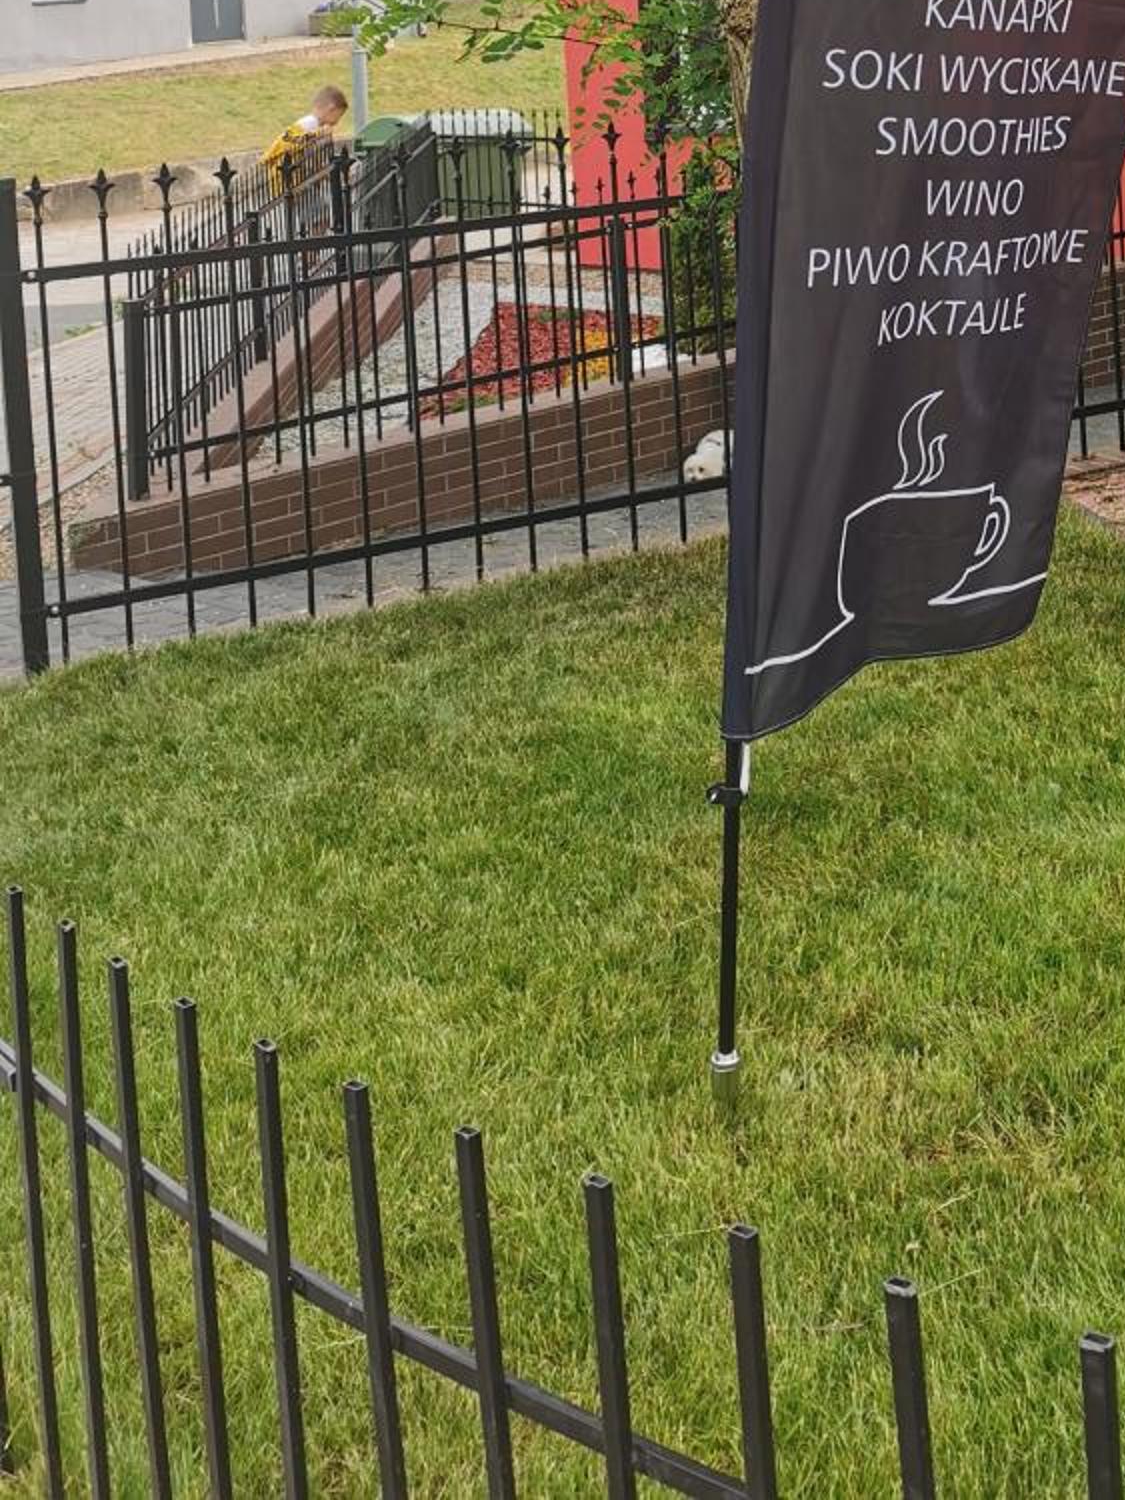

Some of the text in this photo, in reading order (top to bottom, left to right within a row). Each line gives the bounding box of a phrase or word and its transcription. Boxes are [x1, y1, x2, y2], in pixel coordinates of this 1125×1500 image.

[822, 48, 924, 91] SOKI
[875, 115, 1071, 156] SMOOTHIES
[926, 178, 1025, 216] WINO
[807, 229, 1089, 288] PIWO KRAFTOWE
[877, 292, 1028, 346] KOKTAJLE
